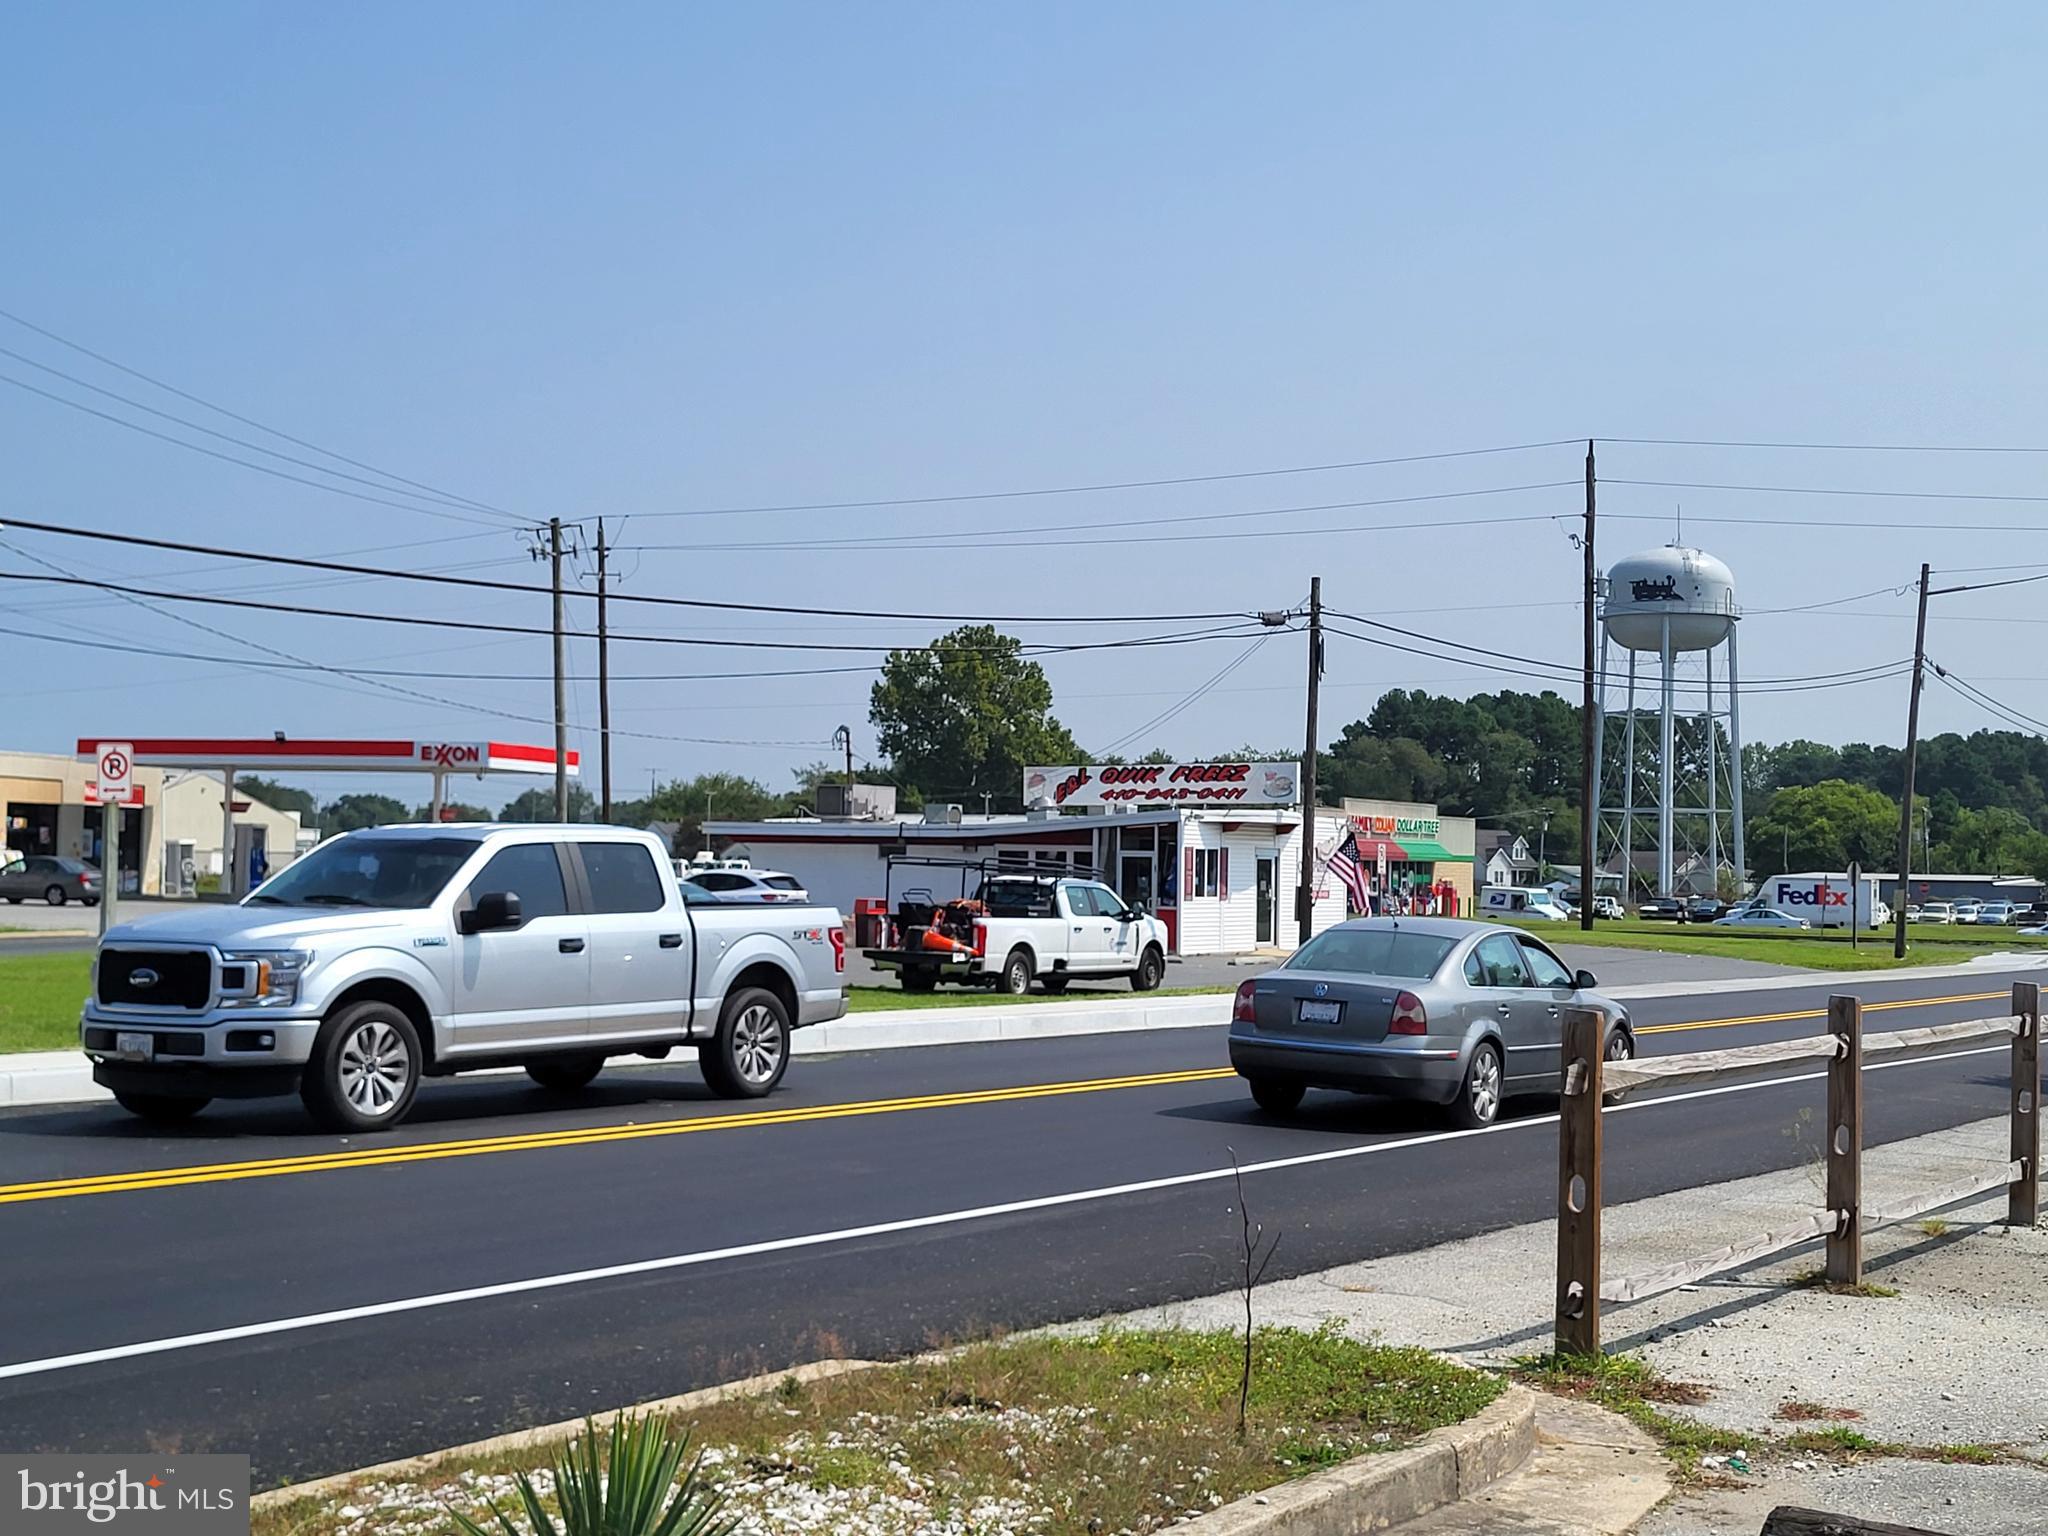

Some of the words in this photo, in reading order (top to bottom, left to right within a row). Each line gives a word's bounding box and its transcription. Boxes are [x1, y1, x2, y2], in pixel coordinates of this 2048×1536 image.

[421, 744, 479, 767] EXXON
[1099, 766, 1165, 784] QUIK
[1168, 764, 1251, 783] FREEZ
[1397, 818, 1423, 832] DOLLAR
[1423, 820, 1440, 834] TREE
[1778, 883, 1848, 906] FedEx
